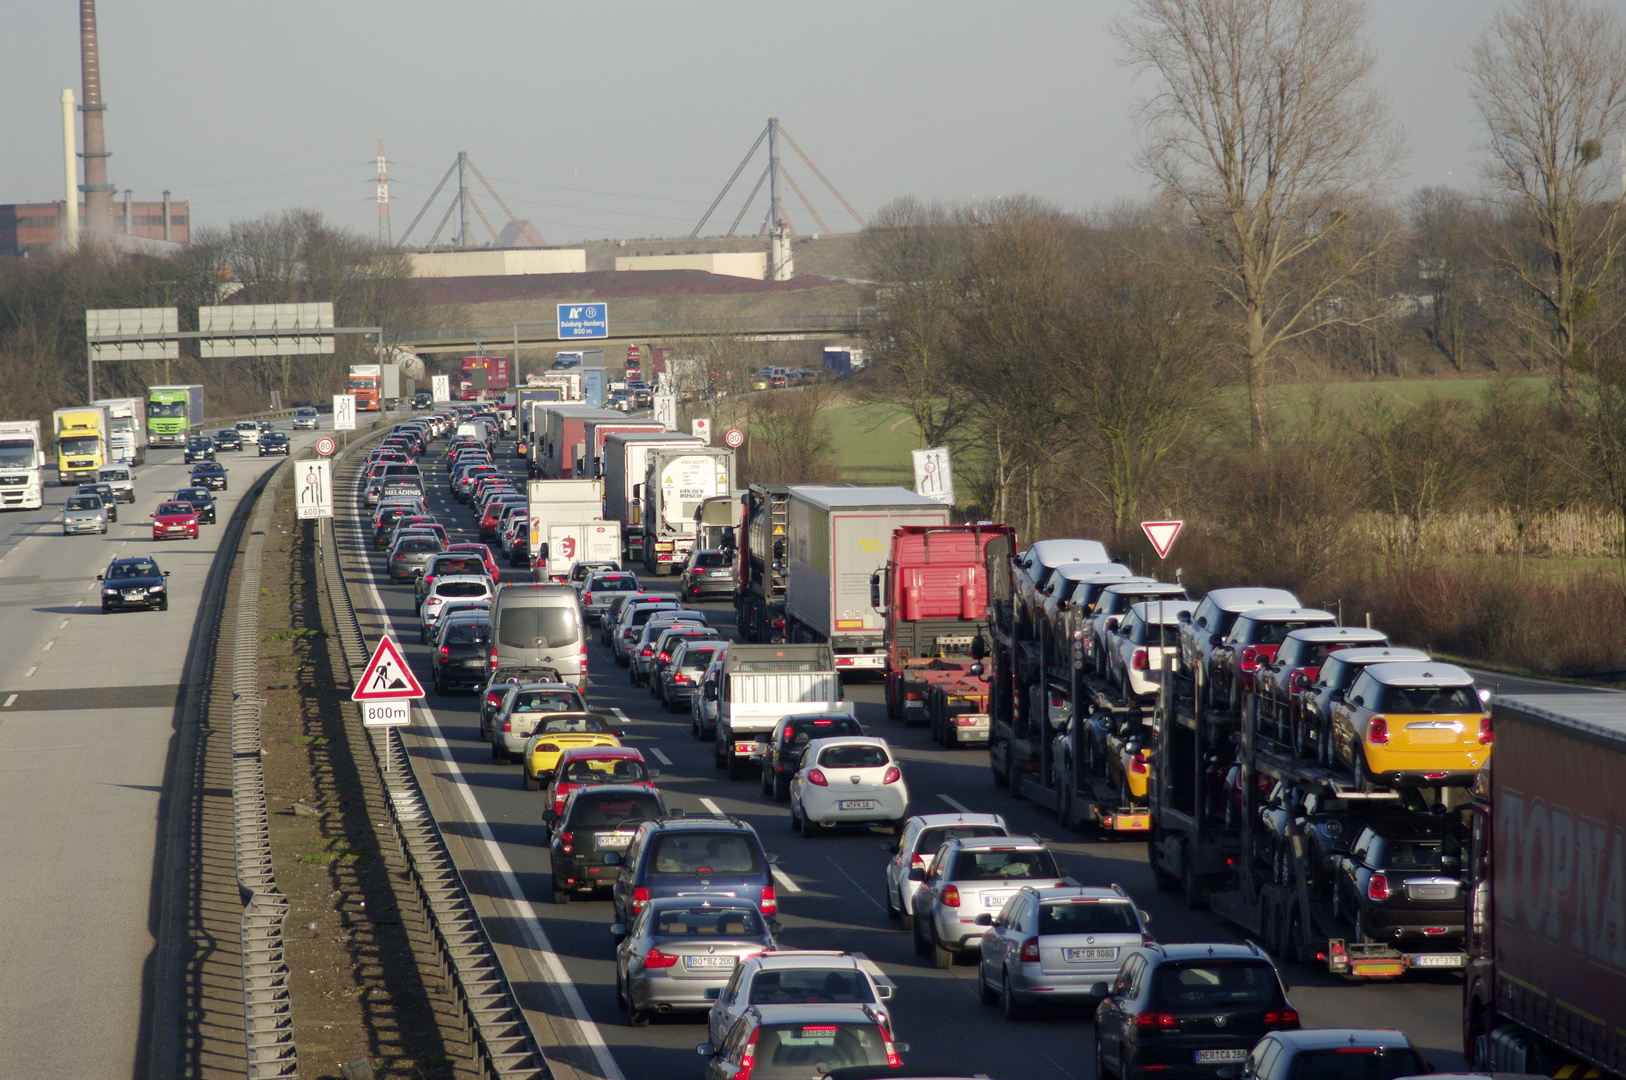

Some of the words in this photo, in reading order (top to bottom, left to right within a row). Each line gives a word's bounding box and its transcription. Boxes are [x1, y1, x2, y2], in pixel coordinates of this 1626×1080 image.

[729, 434, 740, 442] 80
[320, 442, 331, 450] 80
[303, 508, 318, 516] 600
[368, 706, 406, 720] 800m
[1072, 950, 1081, 958] ME
[1086, 949, 1095, 957] DR
[1096, 949, 1114, 958] 8080
[692, 957, 703, 965] BO
[707, 957, 718, 965] BZ
[718, 957, 733, 965] 200
[1199, 1050, 1215, 1060] HER
[1220, 1050, 1231, 1060] CA
[1232, 1050, 1247, 1059] 286
